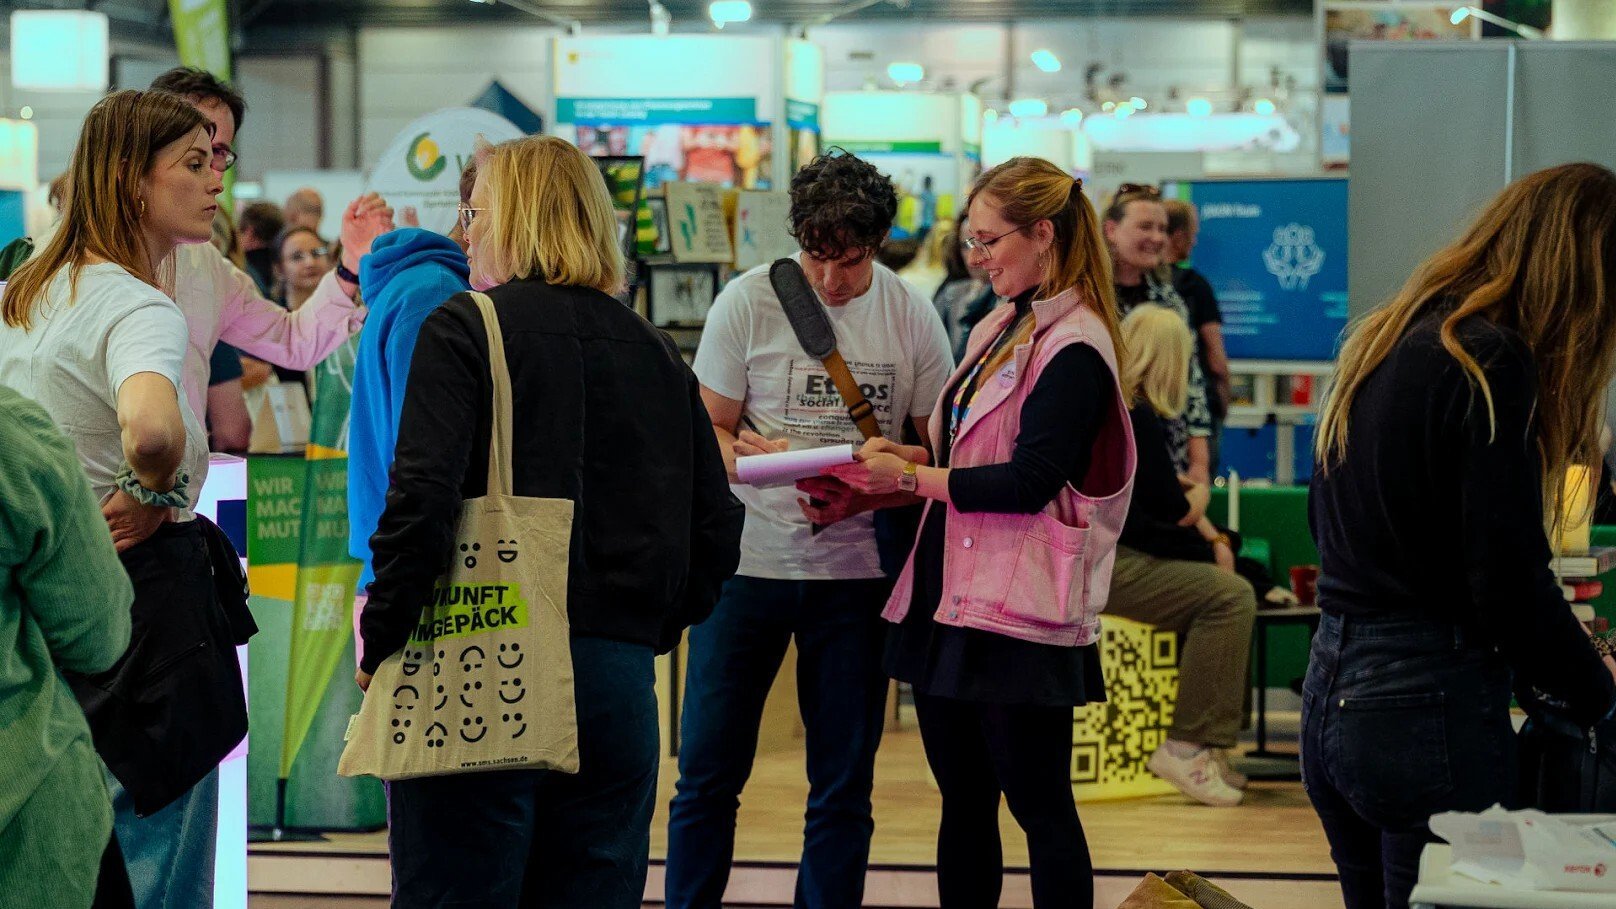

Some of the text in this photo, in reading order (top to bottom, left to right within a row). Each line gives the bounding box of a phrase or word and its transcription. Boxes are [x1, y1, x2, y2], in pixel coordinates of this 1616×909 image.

[806, 375, 889, 400] Etos
[254, 477, 293, 495] WIR
[256, 497, 301, 517] MAC
